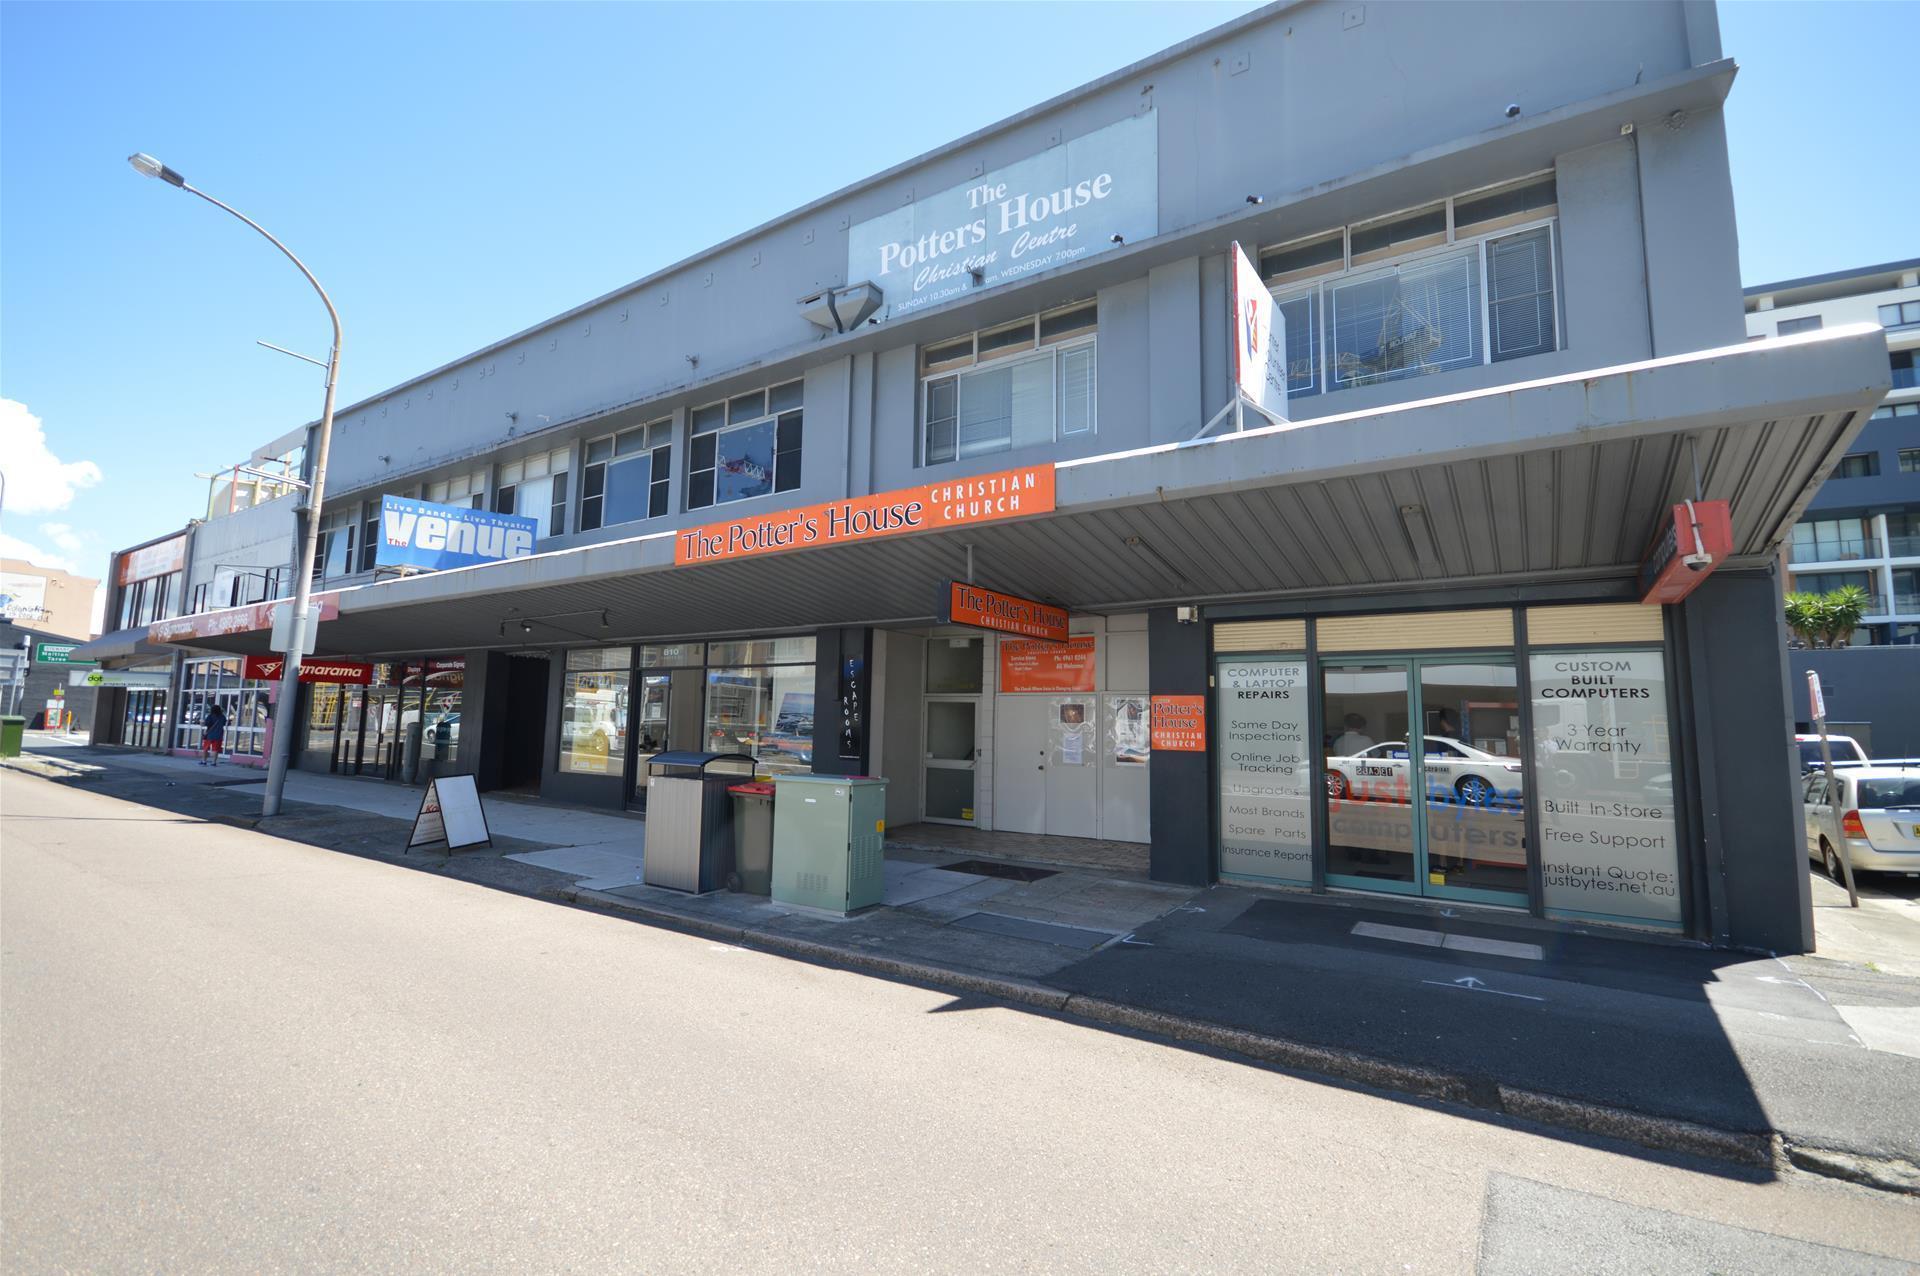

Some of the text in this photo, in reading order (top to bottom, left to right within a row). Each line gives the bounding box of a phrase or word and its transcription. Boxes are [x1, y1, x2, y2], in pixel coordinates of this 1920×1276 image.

[966, 183, 1007, 209] The
[879, 173, 1112, 275] Potters House
[914, 222, 1078, 292] Christian Centre
[898, 297, 928, 311] SUNDAY
[1000, 256, 1053, 278] WEDNESDAY
[930, 472, 1035, 504] CHRISTIAN
[943, 495, 1020, 520] CHURCH
[386, 502, 412, 513] Live
[418, 507, 452, 519] Bands
[464, 514, 486, 524] Live
[491, 518, 533, 530] Theatre
[684, 501, 922, 560] The Potter's House
[388, 538, 407, 548] The
[958, 587, 1065, 629] The Potter's House
[980, 616, 1049, 636] CHRISTIAN CHURCH
[299, 663, 362, 678] gnarama
[1227, 668, 1299, 677] COMPUTER
[1555, 661, 1632, 672] CUSTOM
[1232, 679, 1295, 688] & LAPTOP
[1571, 675, 1615, 685] BUILT
[849, 659, 859, 721] ESCAPE
[1237, 691, 1290, 699] REPAIRS
[1541, 688, 1650, 698] COMPUTERS
[1154, 703, 1203, 716] Potter's
[843, 696, 851, 748] ROOMS
[1154, 716, 1197, 728] House
[1231, 720, 1298, 731] Same Day
[1154, 731, 1202, 740] CHRISTIAN
[1229, 732, 1302, 742] Inspections
[1567, 724, 1627, 737] 3 Year
[1161, 740, 1196, 748] CHURCH
[1555, 739, 1641, 756] Warranty
[1230, 752, 1301, 763] Online Job
[1239, 763, 1293, 775] Tracking
[1328, 772, 1522, 822] just bytes
[1229, 805, 1305, 819] Most Brands
[1545, 800, 1663, 818] Built In-Store
[1228, 823, 1306, 839] Spare Parts
[1545, 828, 1666, 849] Free Support
[1222, 845, 1313, 862] Insurance Reports
[1543, 860, 1674, 883] Instant Quote:
[1543, 873, 1675, 897] justbytes.net.au
